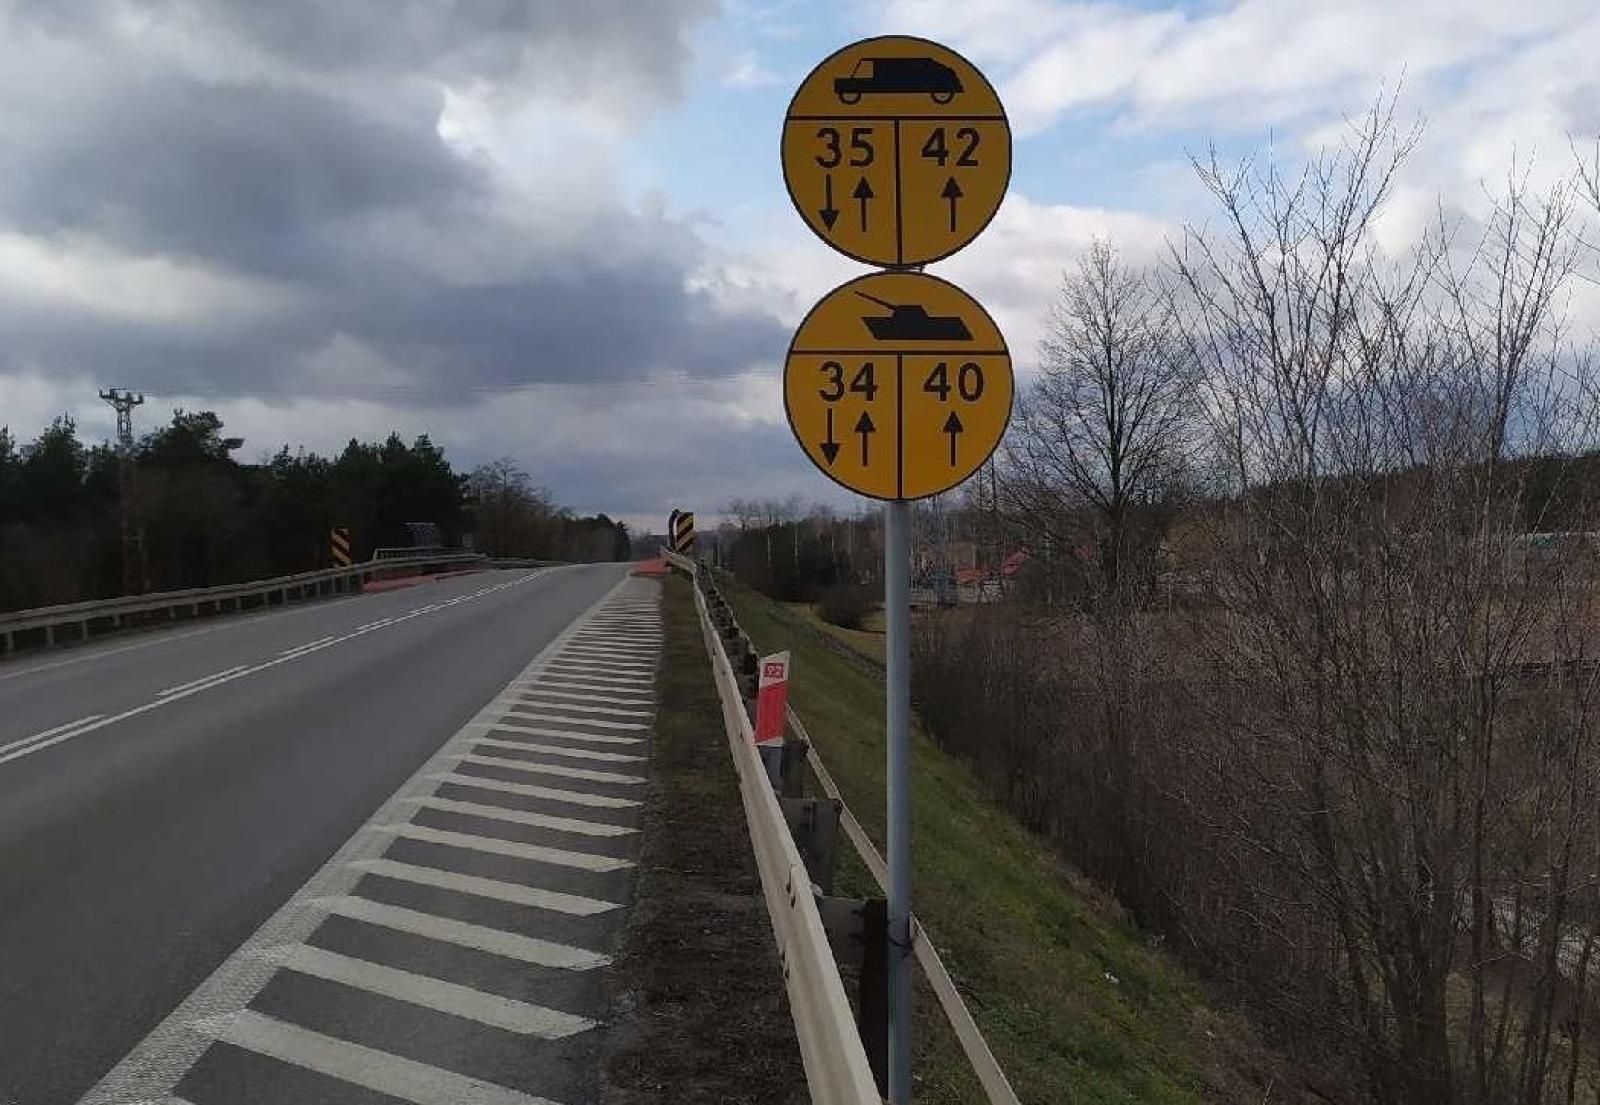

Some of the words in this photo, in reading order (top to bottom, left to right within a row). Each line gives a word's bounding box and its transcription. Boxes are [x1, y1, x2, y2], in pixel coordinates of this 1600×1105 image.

[815, 127, 875, 167] 35
[921, 127, 981, 166] 42
[819, 361, 878, 402] 34
[923, 362, 984, 401] 40
